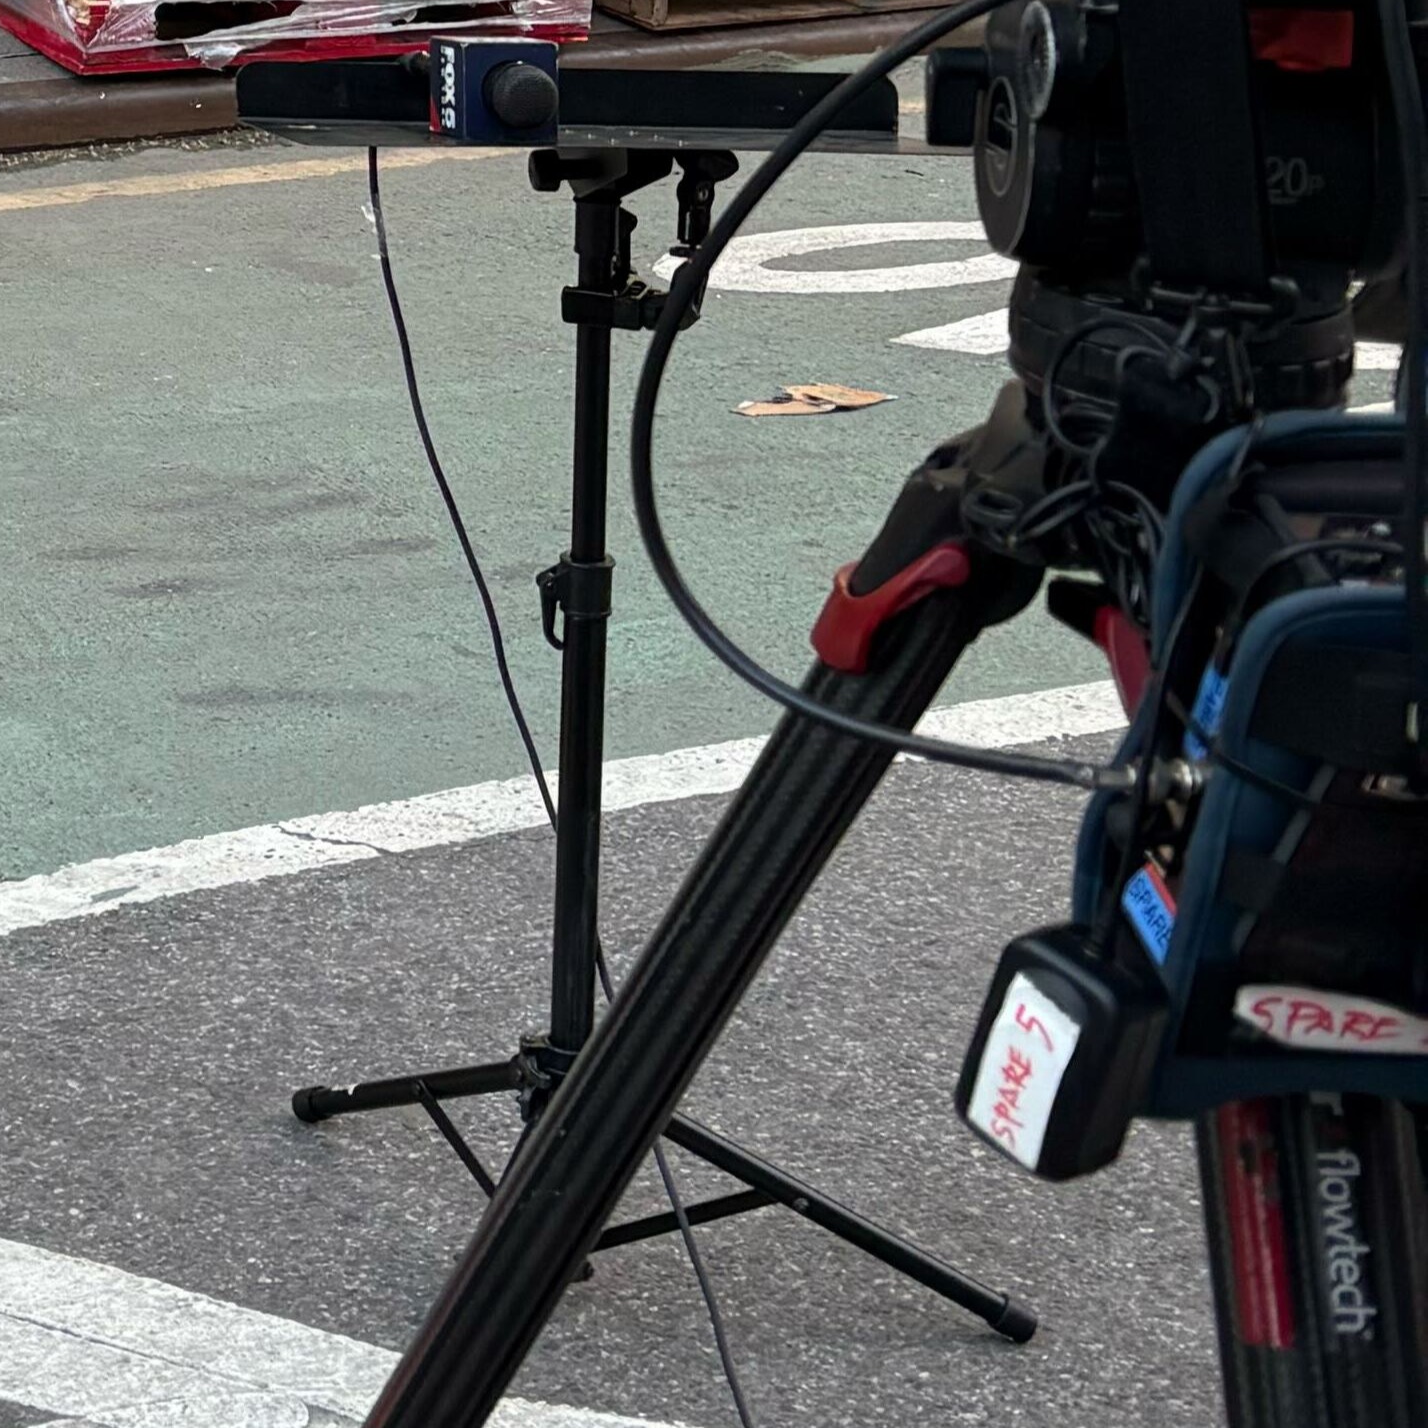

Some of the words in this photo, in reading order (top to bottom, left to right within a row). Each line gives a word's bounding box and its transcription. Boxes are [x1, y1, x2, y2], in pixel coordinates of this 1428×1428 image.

[440, 44, 456, 107] FOX
[1250, 996, 1406, 1041] SPARE
[990, 1045, 1034, 1149] SPARE
[1015, 1003, 1055, 1054] 5
[1316, 1148, 1378, 1334] flowtech
